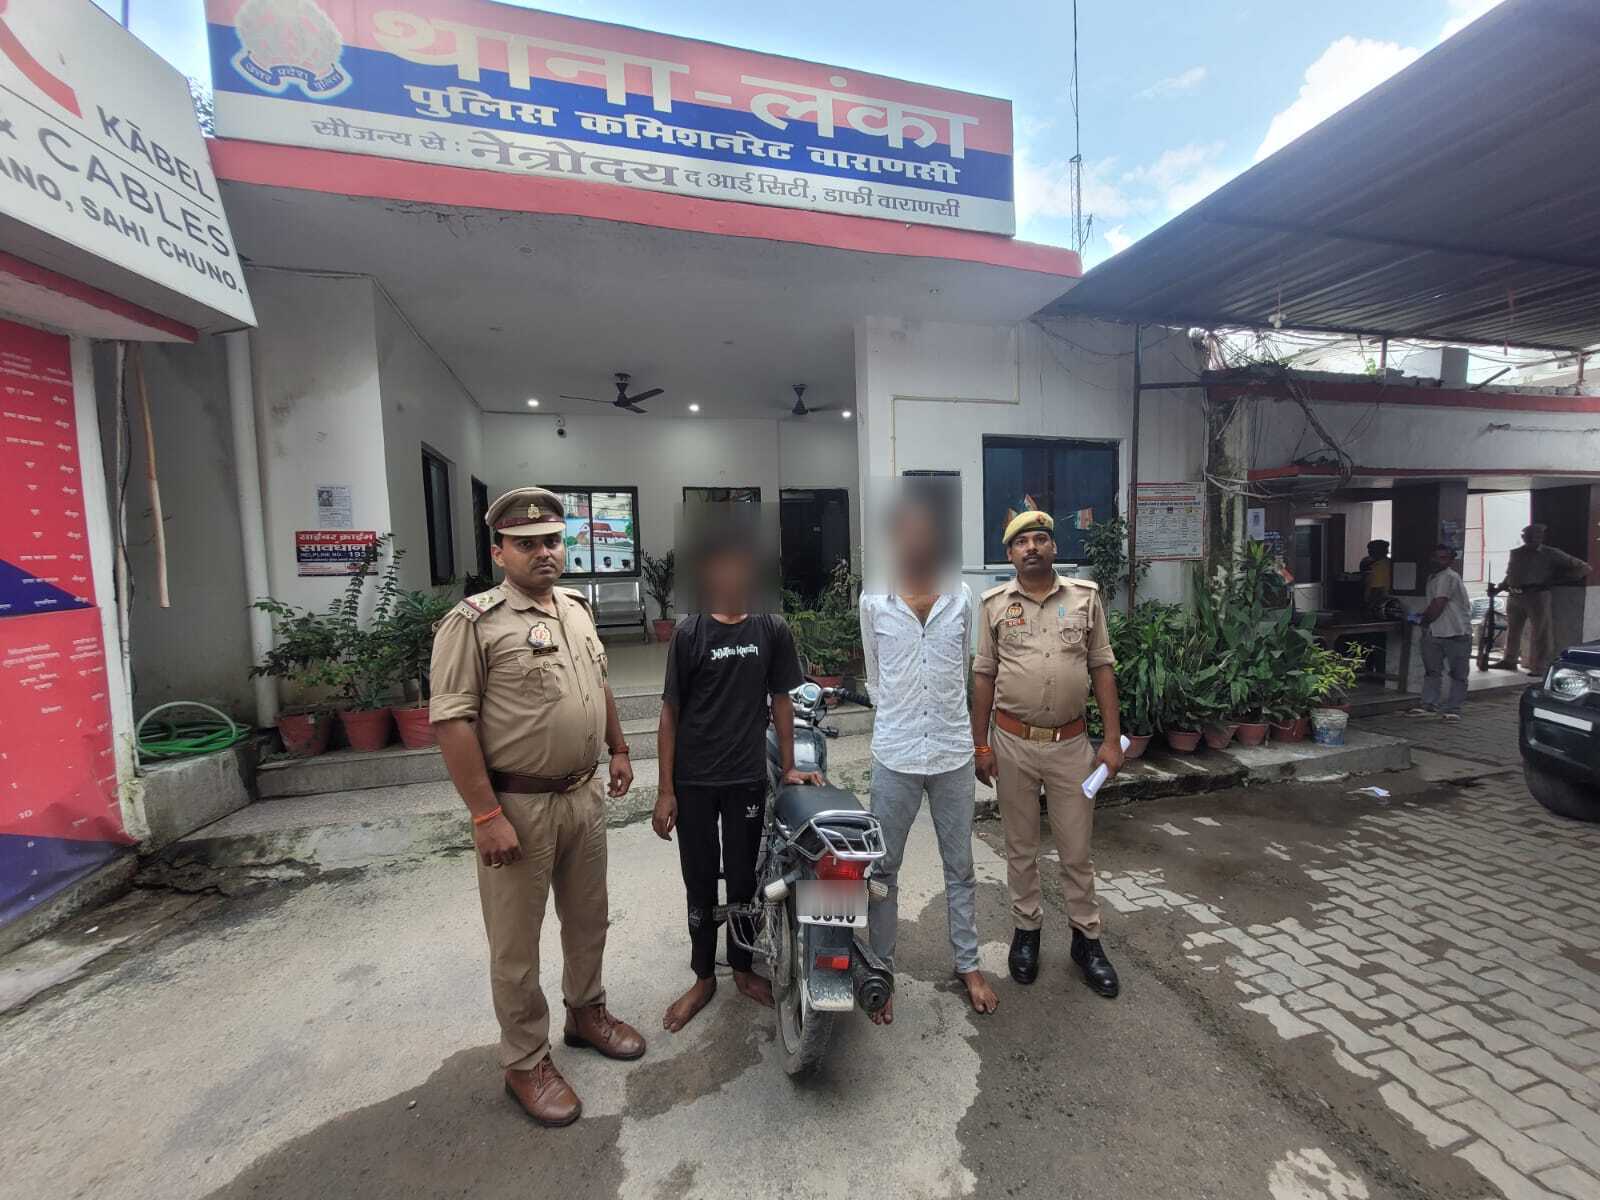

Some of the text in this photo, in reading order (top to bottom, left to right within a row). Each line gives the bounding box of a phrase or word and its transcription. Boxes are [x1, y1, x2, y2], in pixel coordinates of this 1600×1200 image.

[372, 10, 689, 113] थाना
[740, 75, 979, 159] लंका
[403, 84, 560, 127] पुलिस
[806, 145, 960, 185] वाराणसी
[38, 127, 230, 256] CABLES
[311, 117, 413, 147] सौजन्य
[467, 130, 679, 187] नेत्रोदय
[684, 169, 704, 188] द
[707, 172, 754, 195] आई
[757, 174, 818, 202] सिटी,
[823, 186, 874, 207] डाफी
[877, 195, 961, 219] वाराणसी
[80, 195, 150, 248] SAHI
[157, 235, 244, 294] CHUNO.
